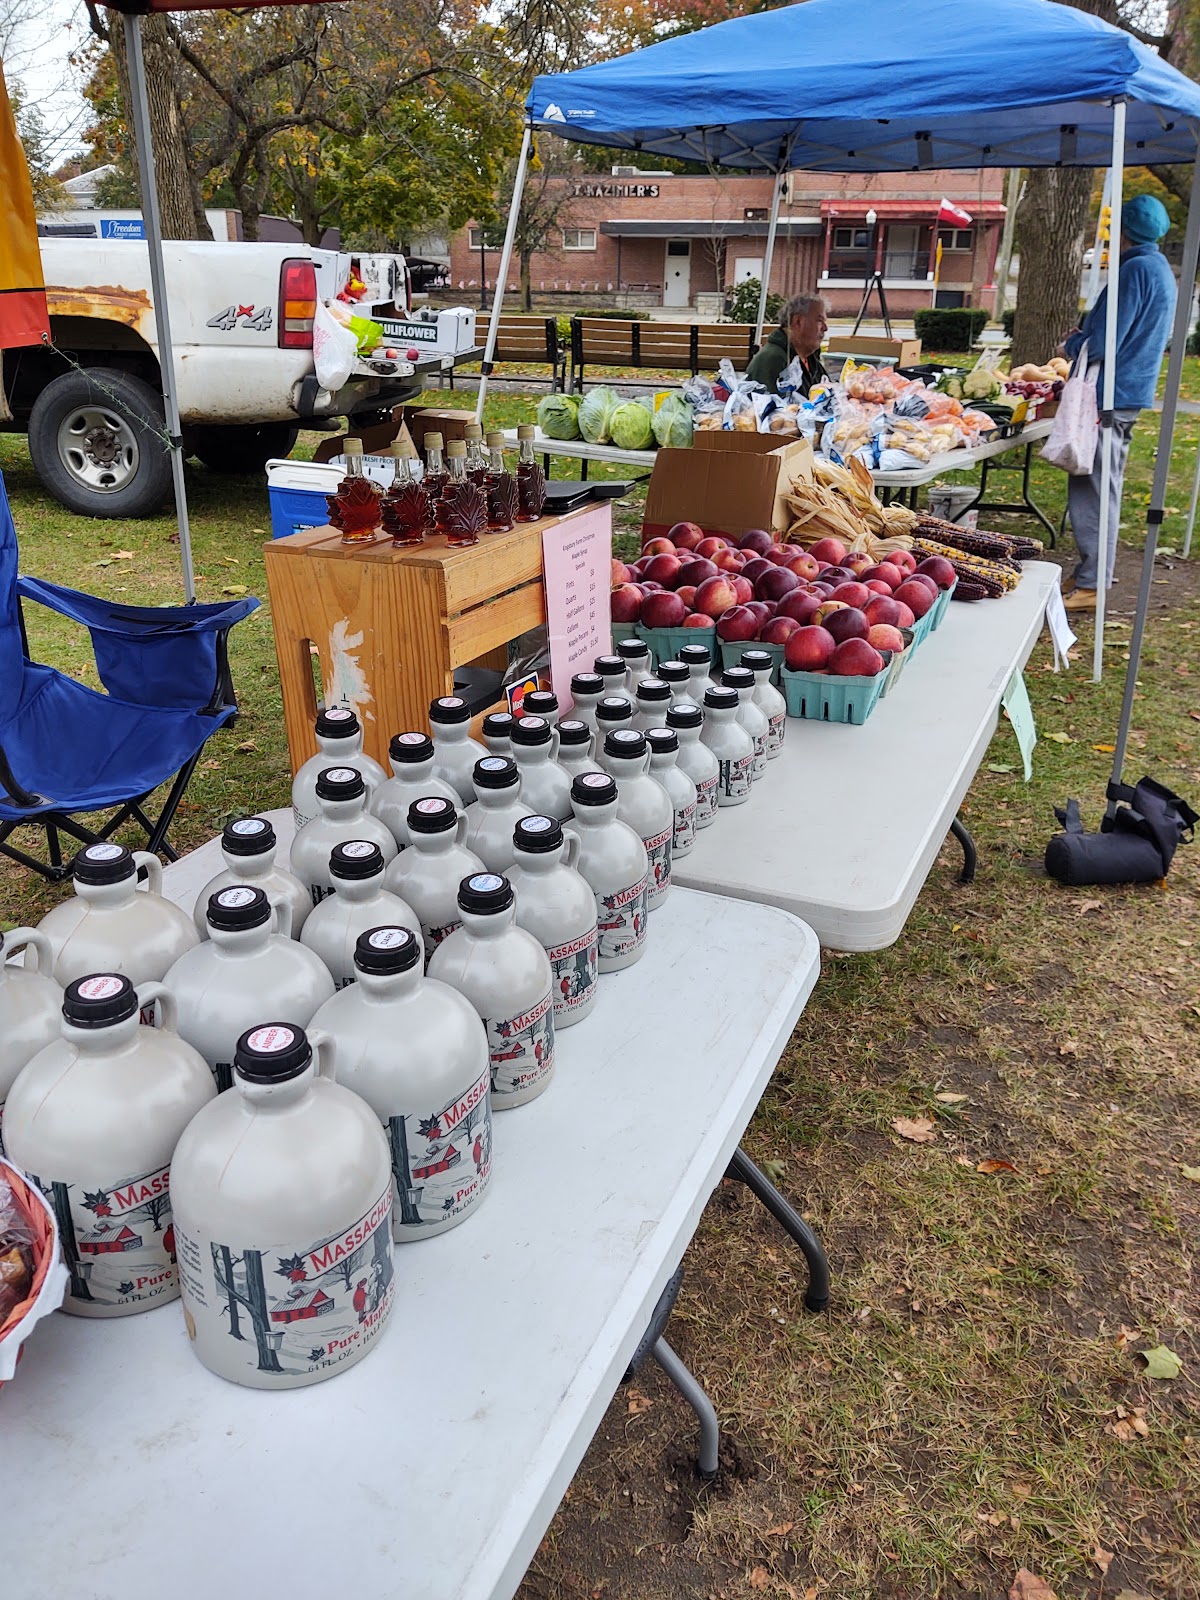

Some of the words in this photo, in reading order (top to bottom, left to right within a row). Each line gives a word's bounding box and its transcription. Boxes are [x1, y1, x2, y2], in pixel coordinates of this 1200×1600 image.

[113, 222, 142, 234] Freedom
[380, 323, 436, 340] ULIFLOWER
[566, 594, 576, 605] Quarts
[567, 622, 578, 634] Gallons
[229, 890, 244, 904] DARK
[380, 932, 396, 945] DARK
[90, 978, 110, 996] AMBER
[566, 994, 586, 1006] Maple
[262, 1028, 278, 1050] AMBER
[520, 1071, 538, 1083] Pure
[456, 1179, 478, 1202] Pure
[442, 1212, 452, 1222] 64
[136, 1268, 172, 1290] Pure
[118, 1297, 129, 1305] 64
[328, 1331, 360, 1354] Pure
[363, 1297, 388, 1332] Maple
[308, 1363, 320, 1373] 64
[338, 1349, 355, 1361] OZ.
